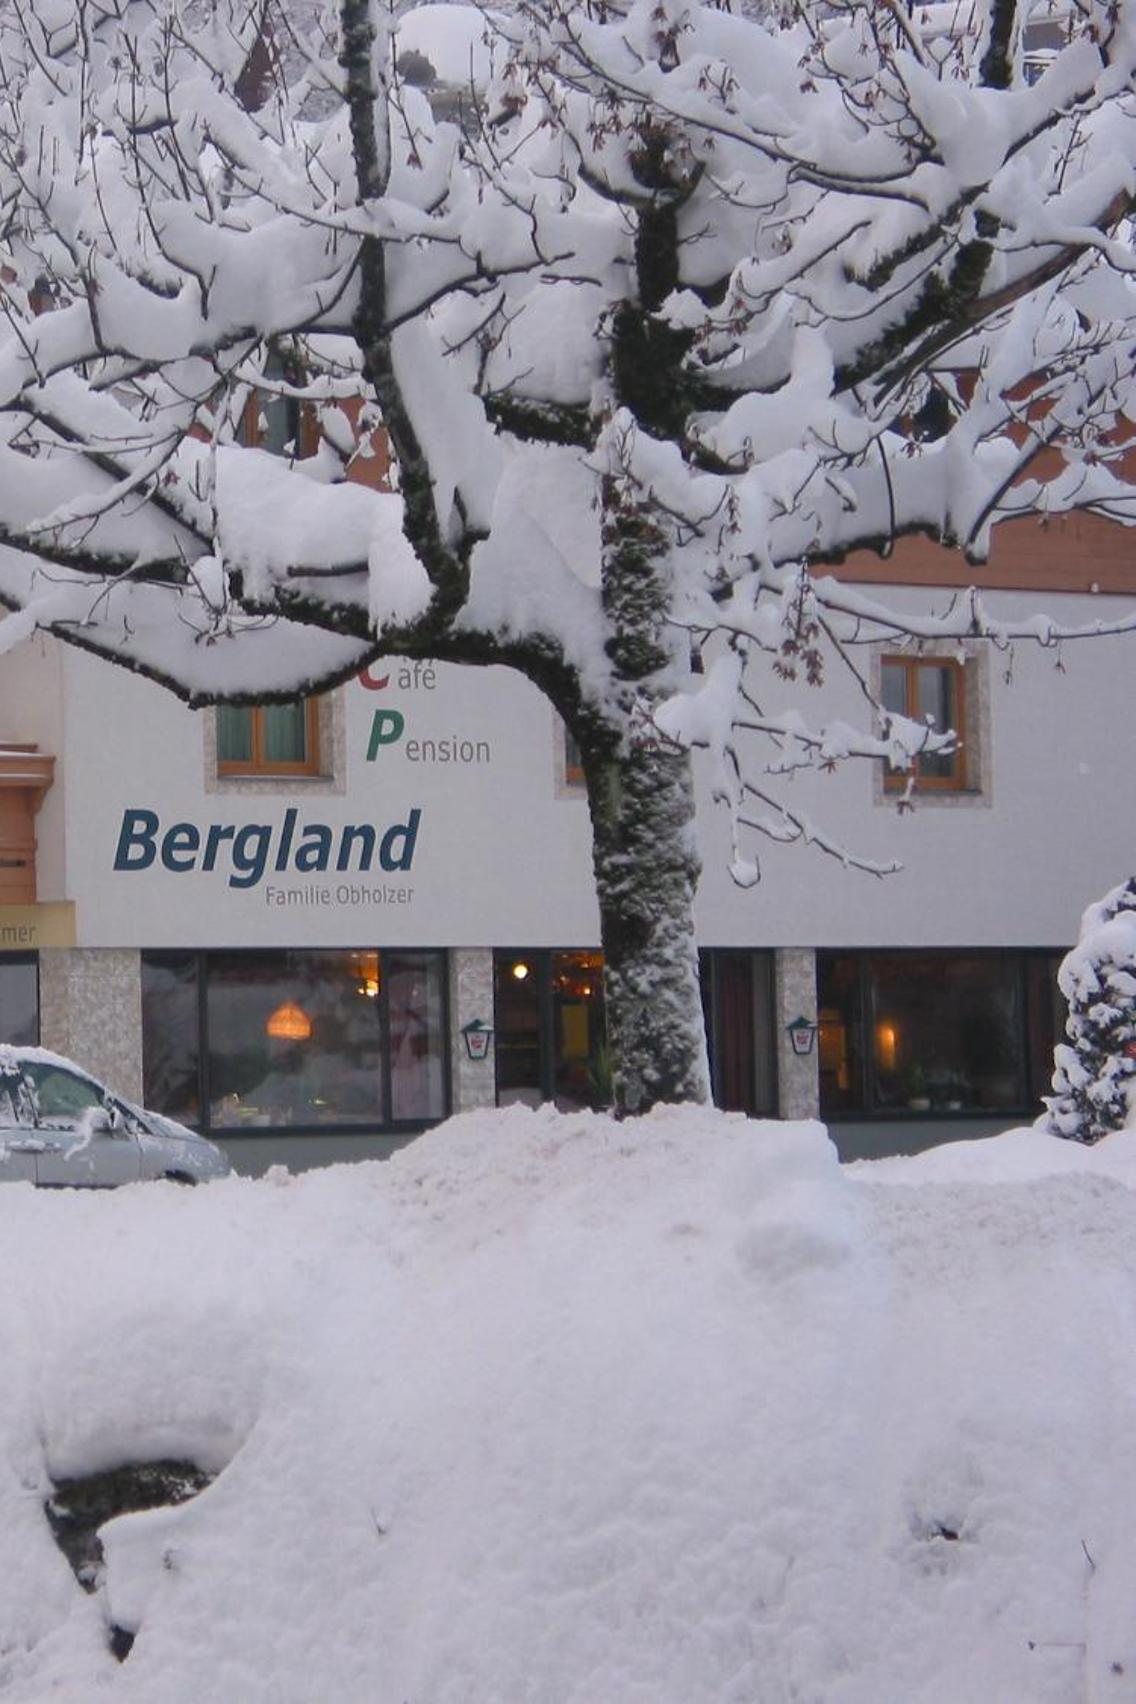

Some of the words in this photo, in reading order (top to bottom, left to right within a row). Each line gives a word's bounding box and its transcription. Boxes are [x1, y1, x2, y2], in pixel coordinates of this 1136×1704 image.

[366, 709, 491, 763] Pension
[113, 808, 422, 889] Bergland
[266, 886, 331, 905] Familie
[337, 886, 414, 906] Obholzer
